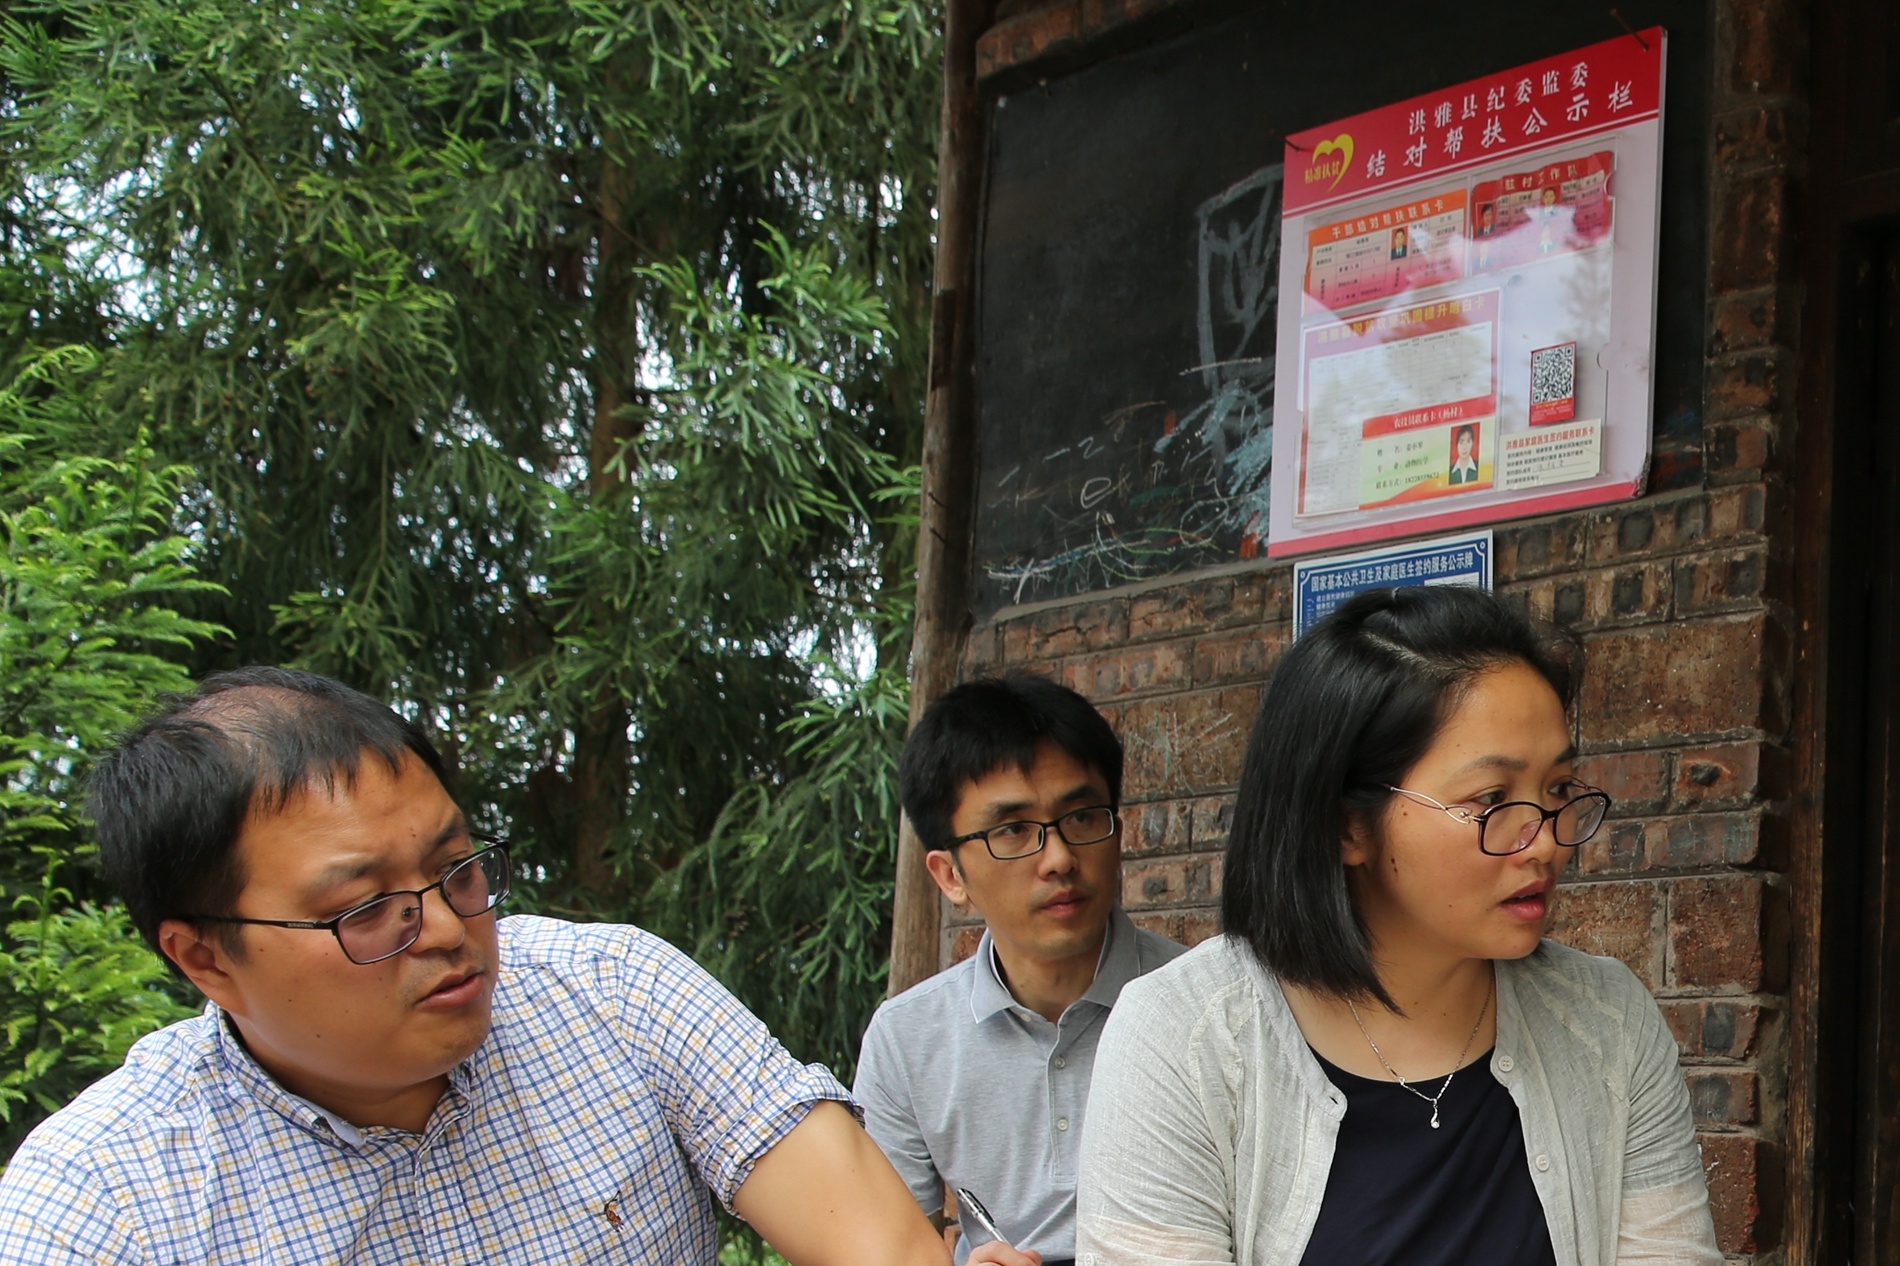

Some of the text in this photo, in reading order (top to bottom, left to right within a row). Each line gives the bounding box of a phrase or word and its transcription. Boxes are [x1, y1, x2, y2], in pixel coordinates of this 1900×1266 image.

[1408, 61, 1589, 136] 洪雅县纪委监委
[1365, 80, 1633, 179] 结对帮扶公示栏
[1332, 199, 1444, 239] 干部结对帮扶联系卡
[1311, 551, 1474, 593] 国家基本公共卫生及家庭医生签约服务公示牌
